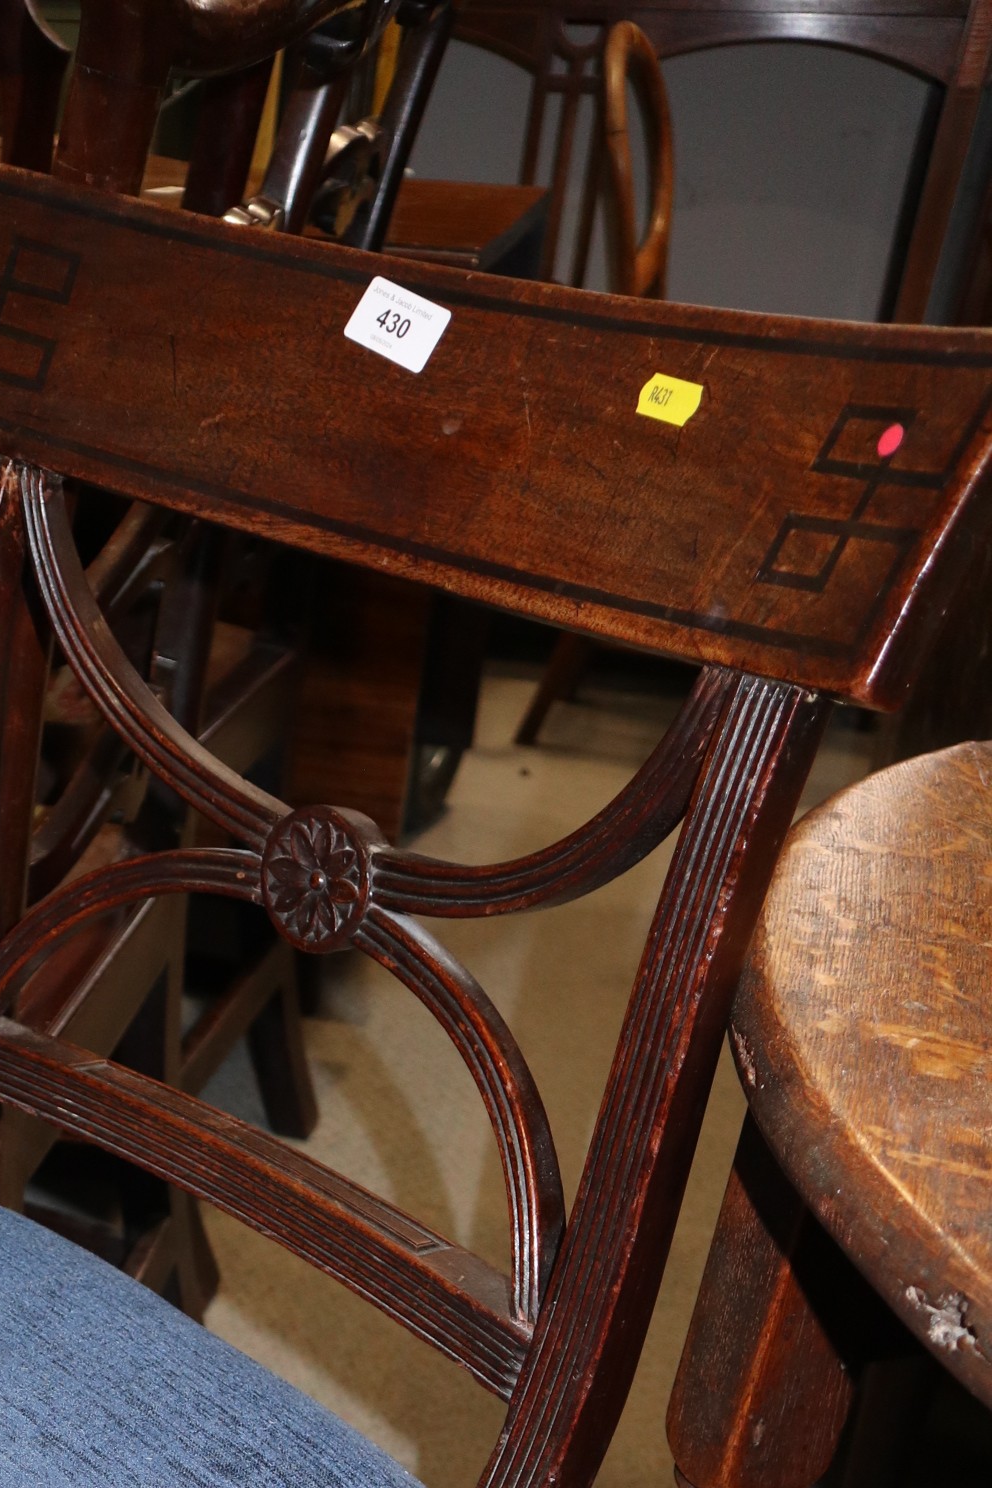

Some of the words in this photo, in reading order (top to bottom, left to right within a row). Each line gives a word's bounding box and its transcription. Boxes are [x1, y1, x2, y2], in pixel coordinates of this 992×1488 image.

[373, 286, 390, 299] Jones
[395, 296, 413, 311] Jacob
[412, 305, 433, 321] Limited
[376, 308, 411, 339] 430
[648, 385, 673, 407] R431
